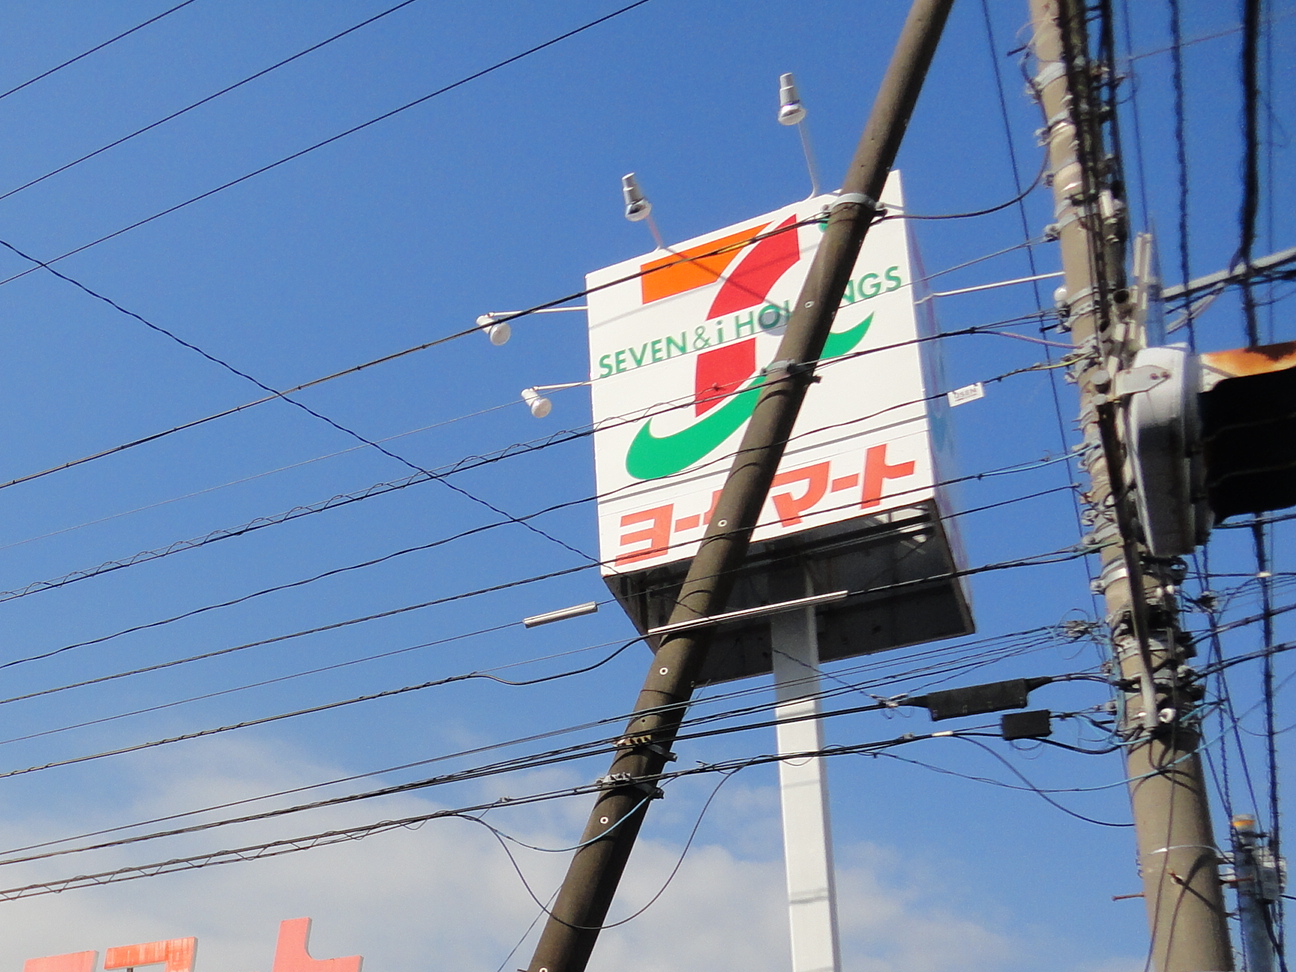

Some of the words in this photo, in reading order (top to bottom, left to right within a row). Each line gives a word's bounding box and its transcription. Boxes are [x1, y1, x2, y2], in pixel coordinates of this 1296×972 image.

[735, 265, 903, 339] HOLNGS
[614, 443, 916, 568] ヨーマート
